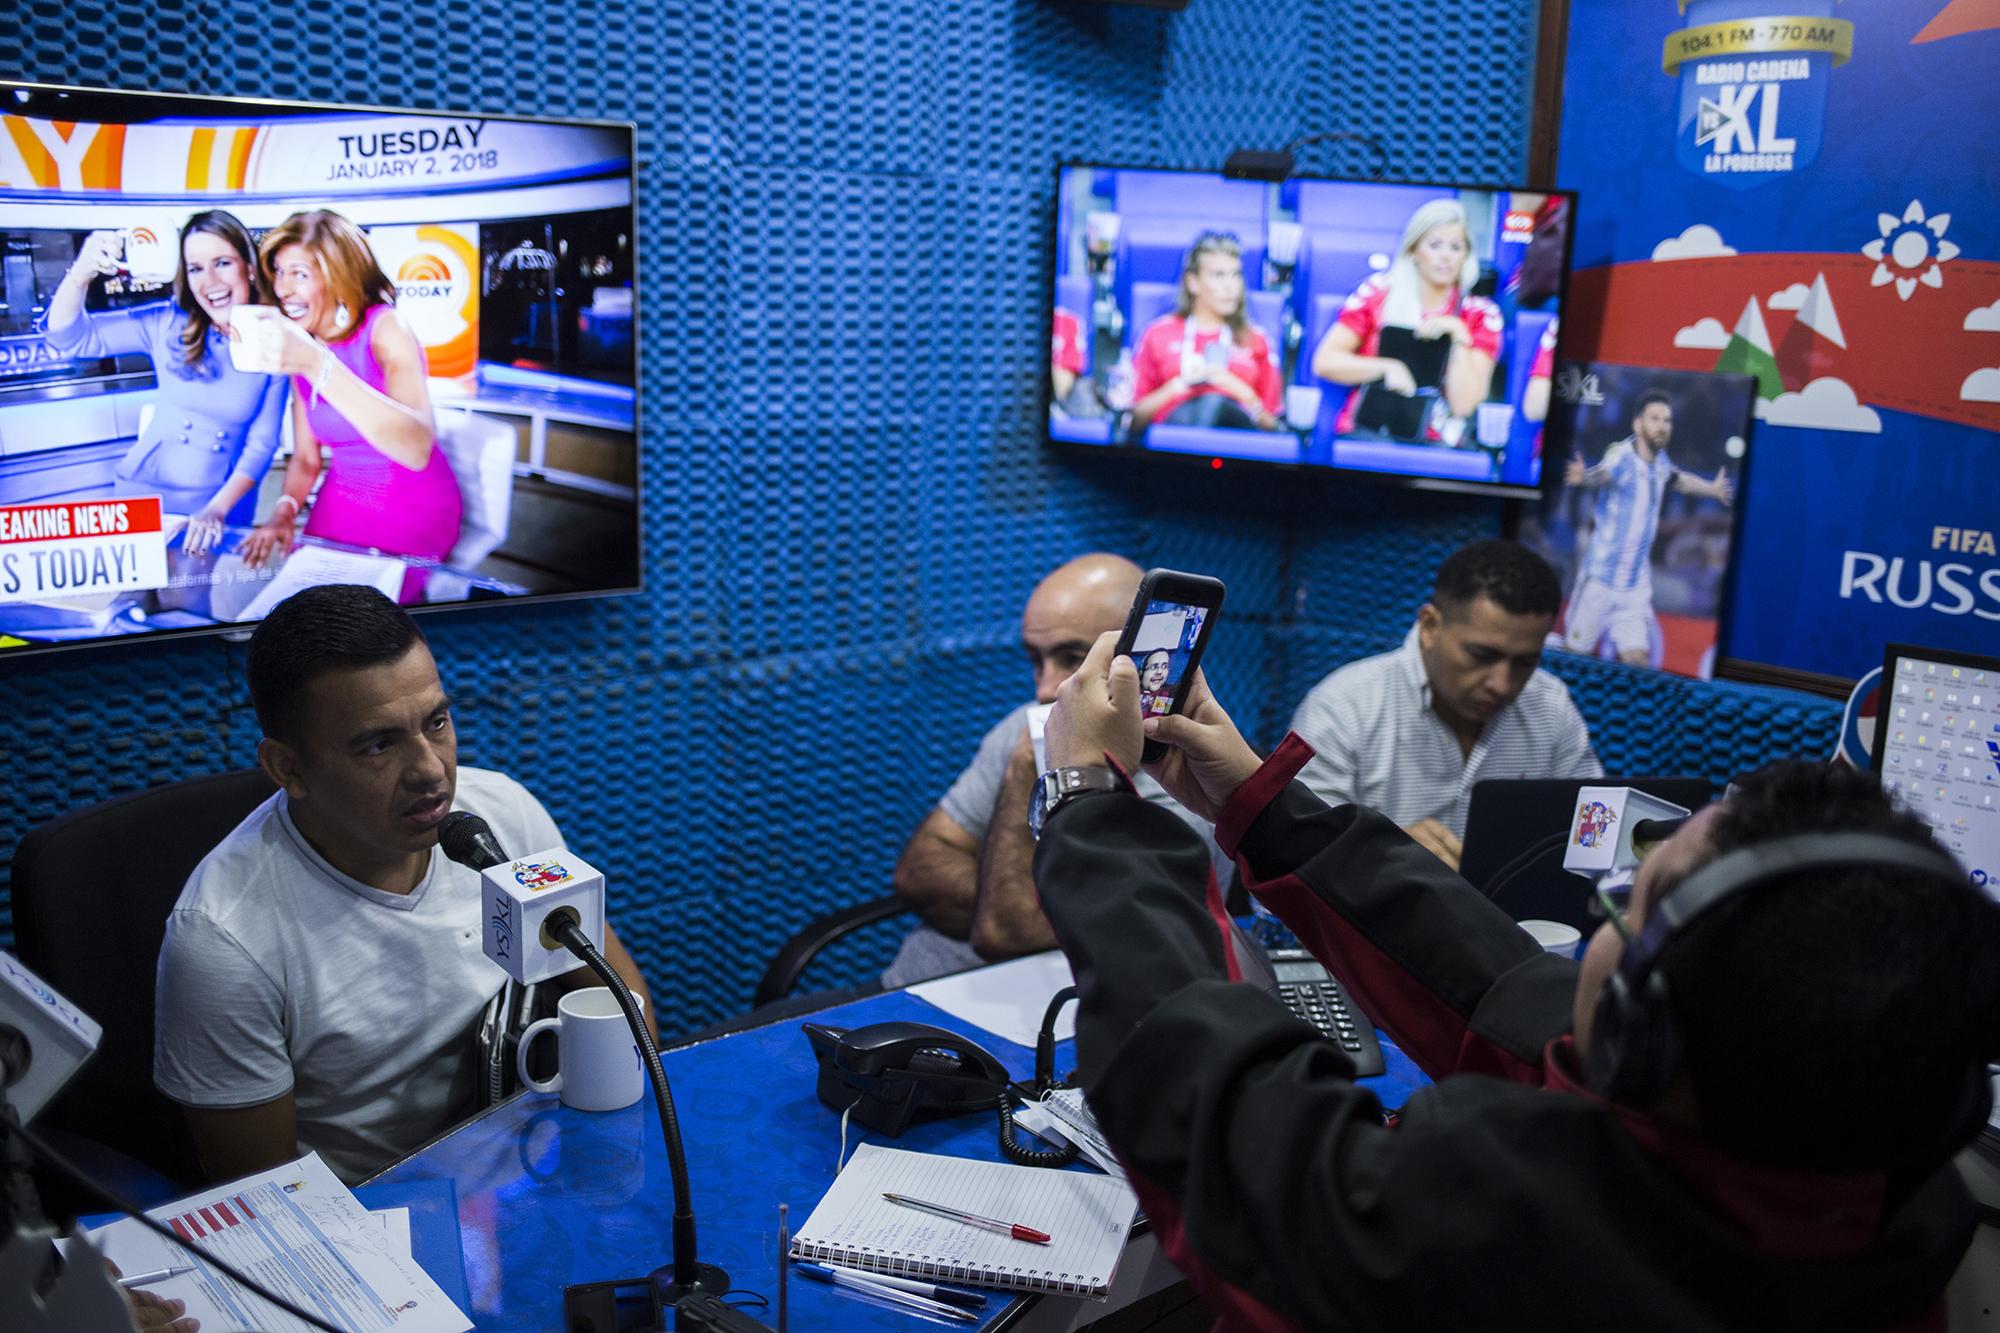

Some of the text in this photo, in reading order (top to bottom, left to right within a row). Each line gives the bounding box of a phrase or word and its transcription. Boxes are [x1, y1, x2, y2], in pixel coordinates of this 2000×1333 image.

[1680, 32, 1725, 53] 104.1
[1730, 28, 1755, 42] FM
[1768, 25, 1801, 41] 770
[1804, 26, 1835, 44] AM
[1696, 58, 1810, 85] RADIO CADENA
[338, 119, 488, 159] TUESDAY
[326, 158, 418, 181] JANUARY
[450, 150, 498, 173] 2018
[1704, 154, 1793, 173] LA PODEROSA
[73, 503, 129, 536] NEWS
[1932, 525, 1996, 556] FIFA
[3, 544, 138, 593] S TODAY!
